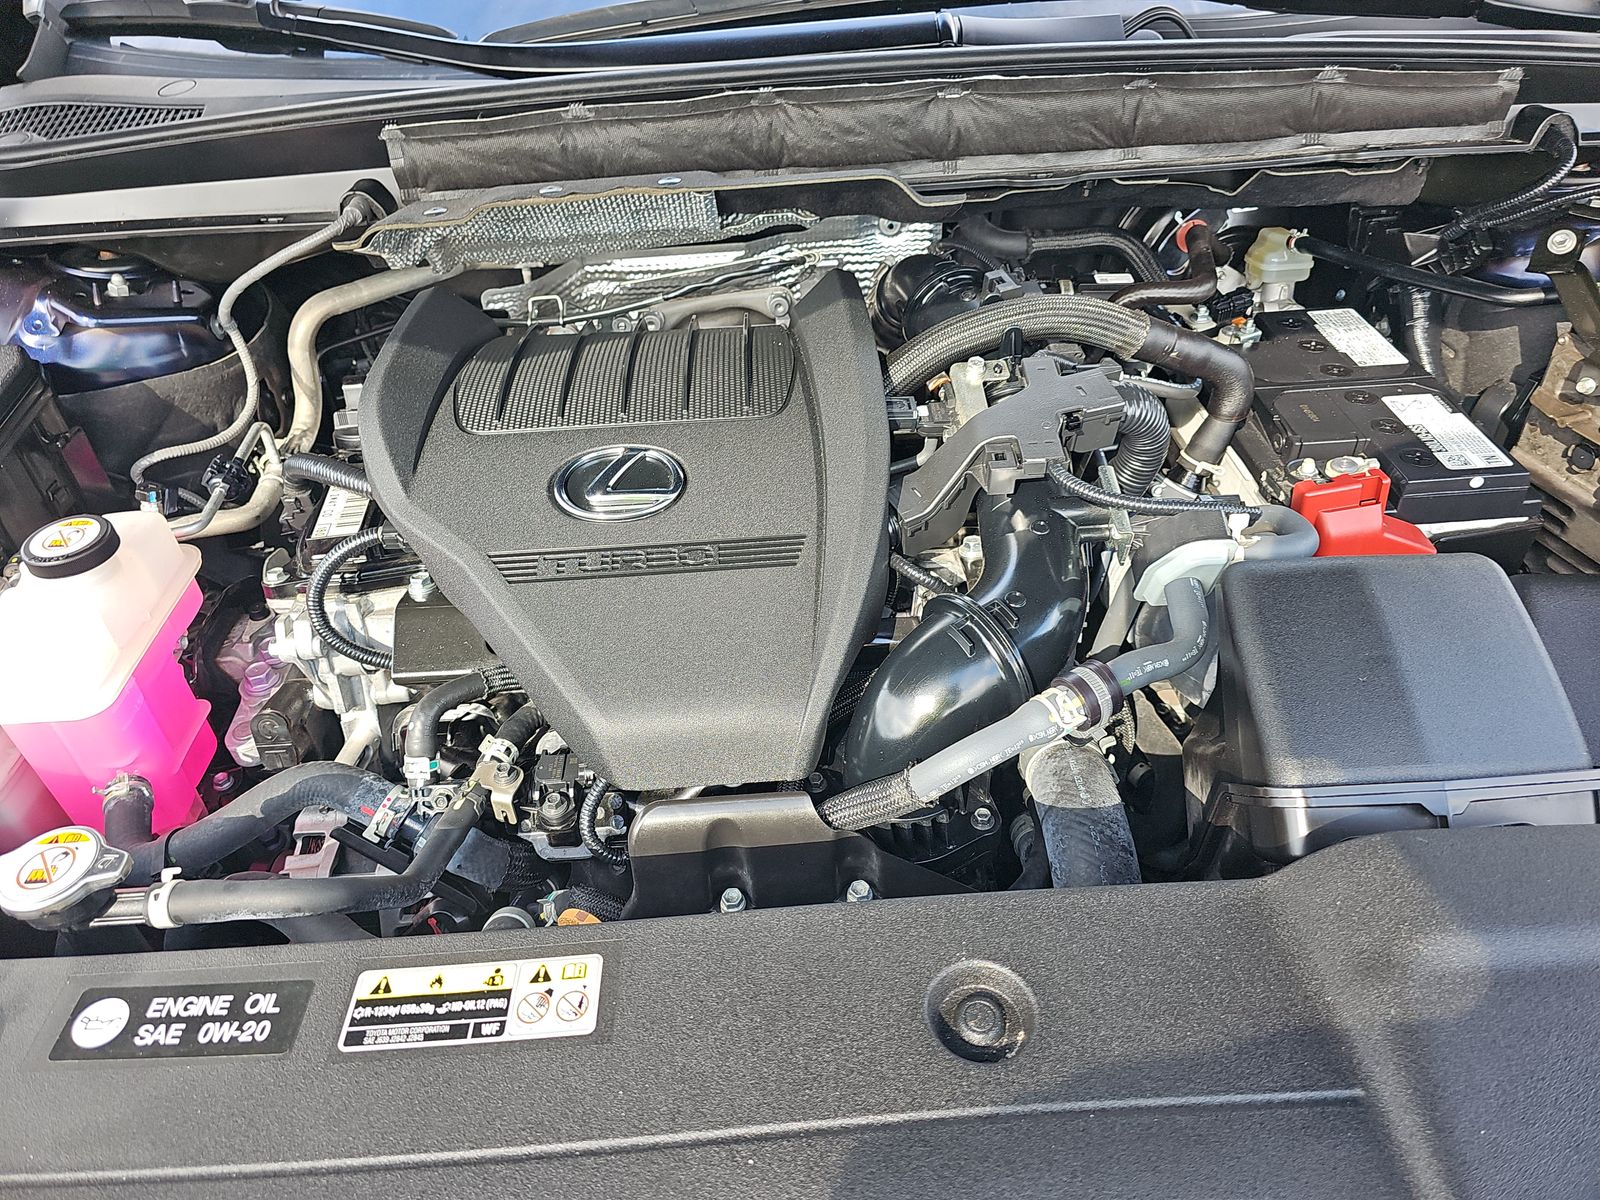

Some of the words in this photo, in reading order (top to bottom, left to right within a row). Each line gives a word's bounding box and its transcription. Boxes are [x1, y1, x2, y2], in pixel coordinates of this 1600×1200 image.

[543, 545, 714, 574] TURBO
[146, 994, 234, 1018] ENGINE
[244, 992, 281, 1015] OIL
[133, 1023, 186, 1046] SAE
[197, 1019, 272, 1044] 0W-20
[365, 1028, 388, 1037] TOYOTA
[388, 1027, 410, 1036] MOTOR
[409, 1025, 450, 1034] CORPORATION
[480, 1023, 501, 1036] WF
